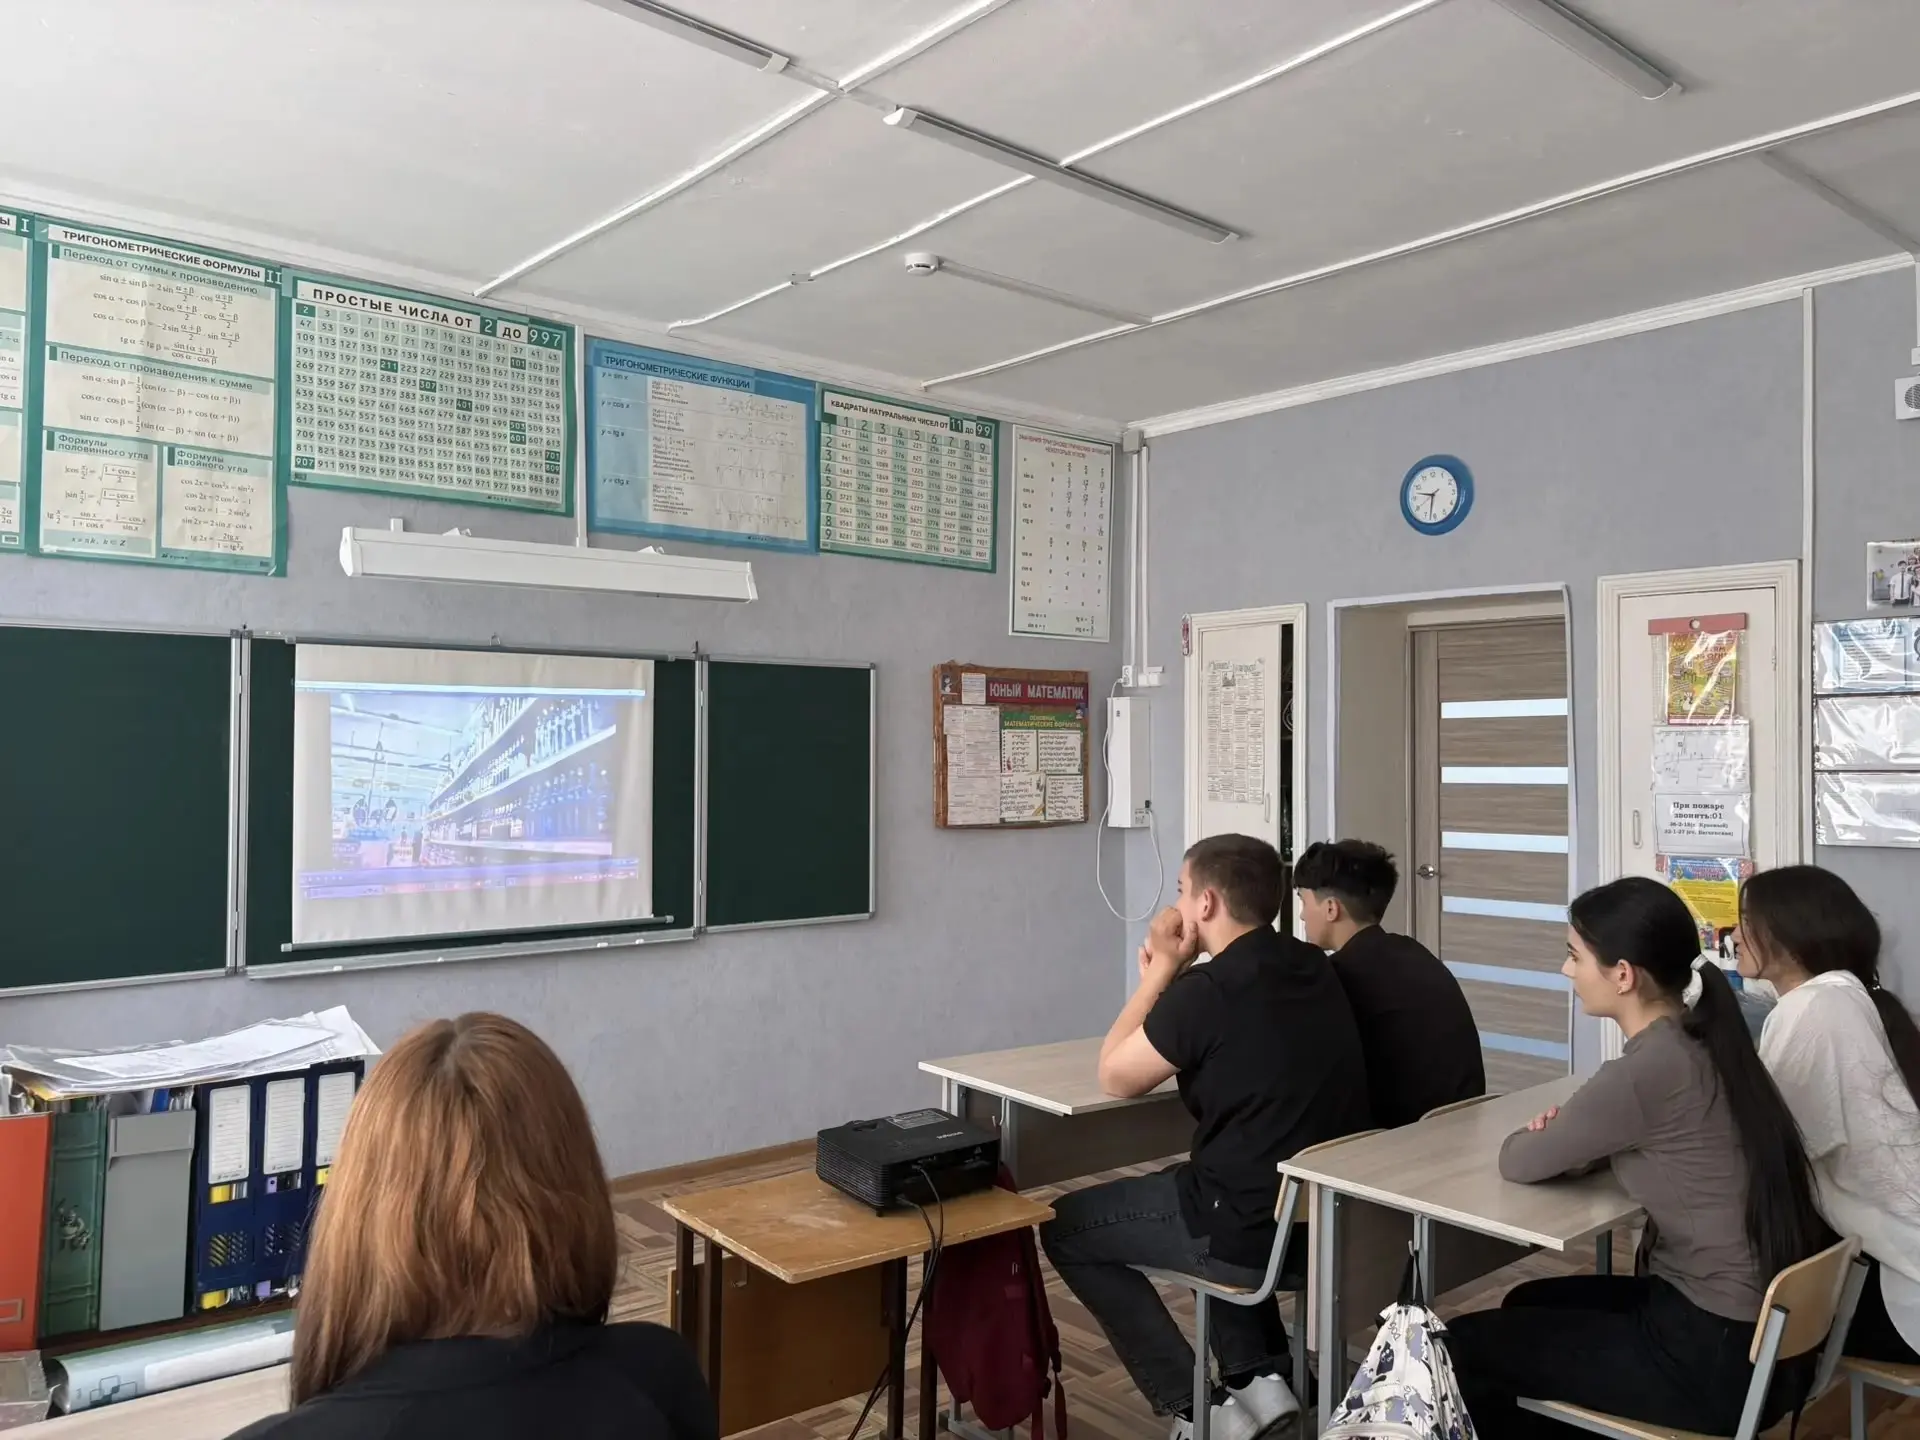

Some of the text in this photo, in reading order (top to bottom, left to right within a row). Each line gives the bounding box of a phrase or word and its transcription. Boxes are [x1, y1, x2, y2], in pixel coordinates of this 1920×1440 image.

[62, 230, 200, 265] ТРИГОНОМЕТРИЧЕСКИЕ
[202, 258, 260, 278] ФОРМУЛЫ
[63, 248, 113, 266] Переход
[116, 259, 128, 268] от
[132, 262, 168, 275] суммы
[180, 272, 258, 294] произведению
[313, 288, 561, 346] ПРОСТЫЕ ЧИСЛА ОТ 2 ДО 997
[303, 305, 558, 361] 2 3 5 7 11 13 17 19 23 29 31 37 41 43
[61, 351, 110, 367] Переход
[130, 363, 208, 383] произведения
[210, 376, 216, 384] к
[219, 378, 253, 390] сумме
[605, 356, 750, 389] ТРИГОНОМЕТРИЧЕСКИЕ ФУНКЦИИ
[830, 400, 868, 413] КВАДРАТЫ
[869, 408, 916, 424] НАТУРАЛЬНЫХ
[918, 418, 938, 428] ЧИСЕЛ
[940, 421, 948, 429] ОТ
[951, 418, 962, 431] 11
[976, 424, 990, 436] 99
[58, 434, 108, 447] Формулы
[826, 437, 832, 447] 2
[844, 417, 986, 452] 1 2 3 4 5 6 7 8 9
[58, 443, 149, 460] половинного угла
[177, 450, 224, 462] Формулы
[826, 451, 832, 461] 3
[176, 458, 248, 474] двойного угла
[825, 464, 832, 474] 4
[295, 458, 560, 497] 907 911 919 929 937 941 947 953 967 971 977 983 991 997
[826, 477, 832, 487] 5
[826, 490, 832, 500] 6
[826, 503, 832, 513] 7
[826, 516, 832, 526] 8
[825, 529, 832, 540] 9
[990, 682, 1022, 697] ЮНЫЙ
[1028, 685, 1084, 700] МАТЕМАТИК
[1673, 802, 1690, 810] При
